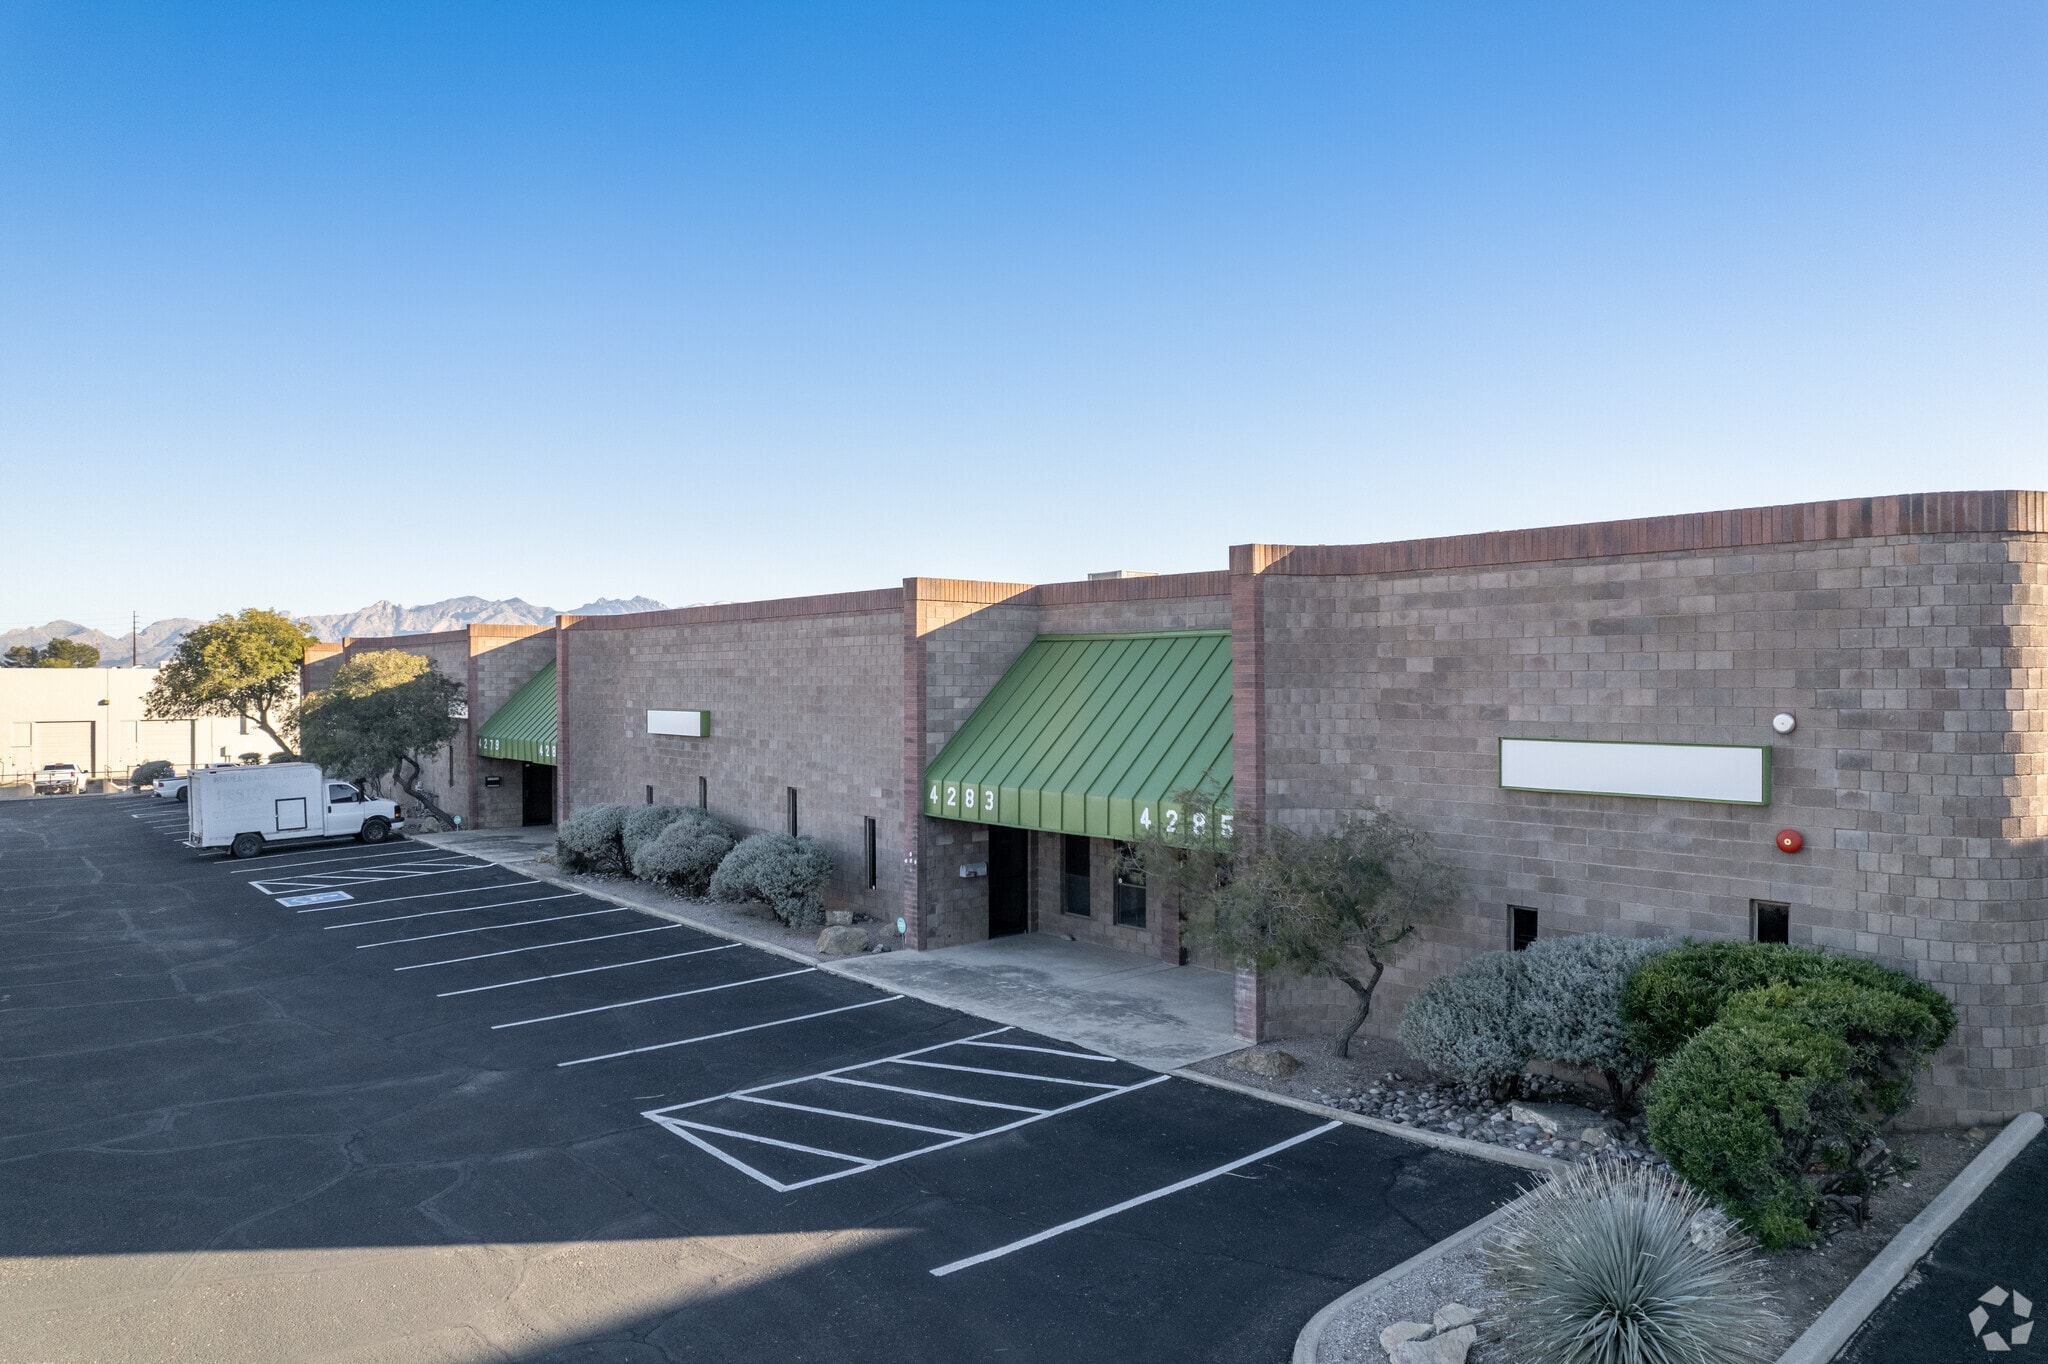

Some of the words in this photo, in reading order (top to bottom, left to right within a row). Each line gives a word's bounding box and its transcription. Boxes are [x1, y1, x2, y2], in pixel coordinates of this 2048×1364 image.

[478, 738, 500, 751] 4279
[539, 744, 557, 757] 428
[930, 785, 994, 811] 4283
[1140, 807, 1234, 840] 4285
